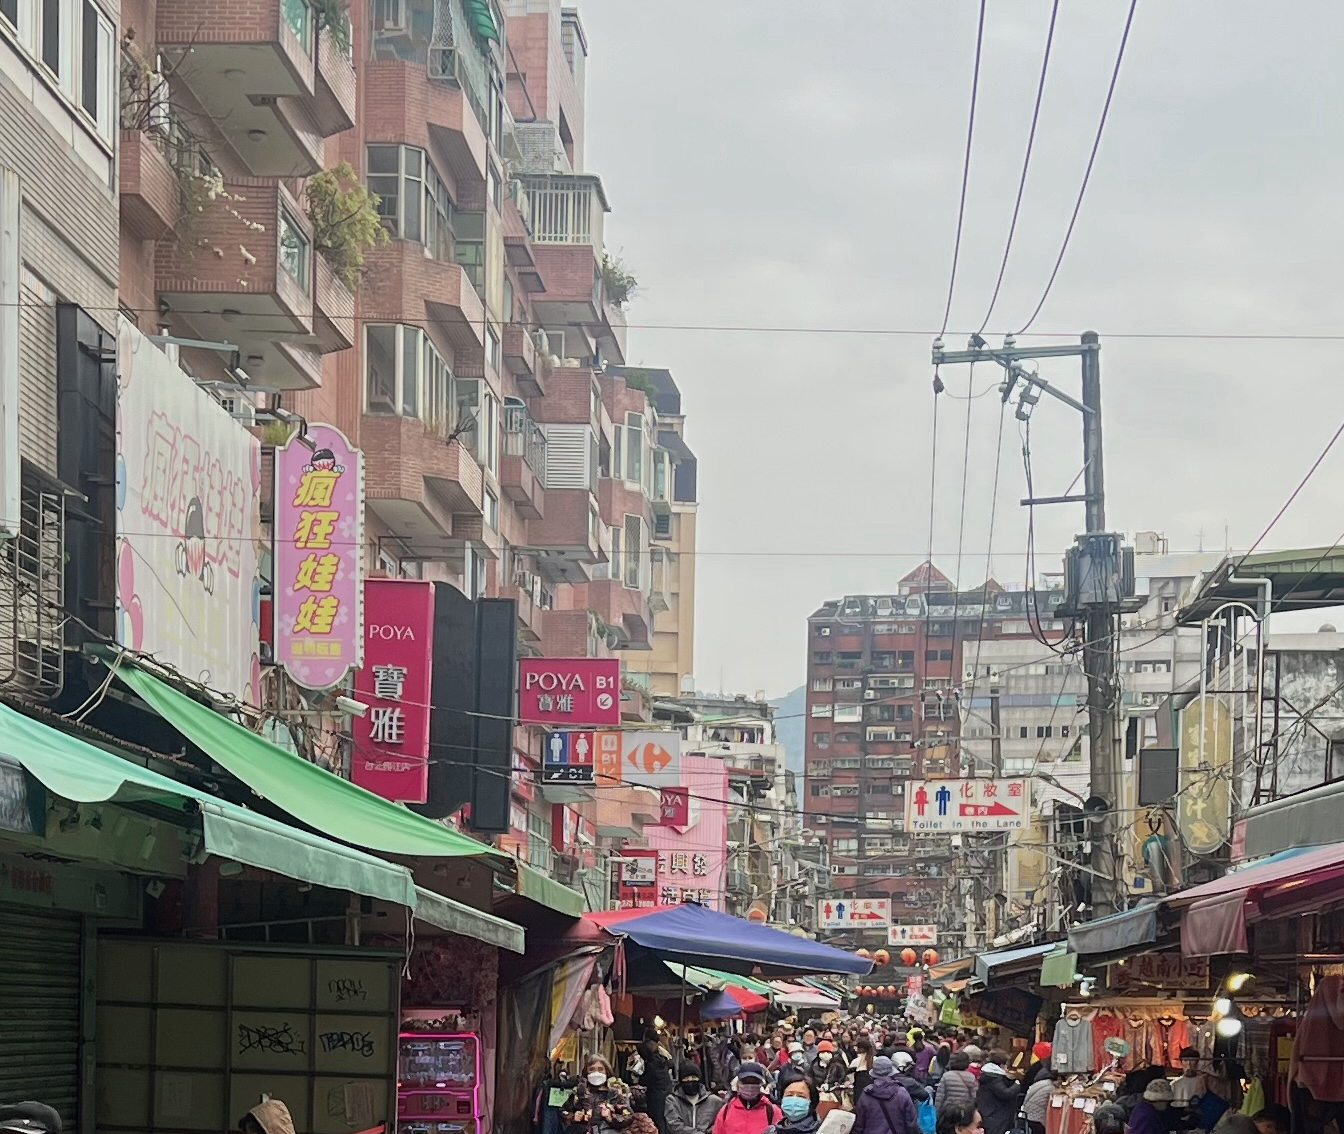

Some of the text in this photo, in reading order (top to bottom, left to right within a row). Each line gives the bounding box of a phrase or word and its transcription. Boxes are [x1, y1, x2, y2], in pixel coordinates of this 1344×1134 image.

[292, 469, 341, 634] 瘋狂娃娃
[369, 624, 415, 641] POYA
[525, 672, 615, 691] POYA B1
[369, 664, 408, 743] 寶雅
[537, 694, 574, 713] 寶雅
[602, 754, 617, 765] B1
[913, 821, 942, 829] Toilet
[971, 820, 988, 829] the
[996, 819, 1022, 828] Lane
